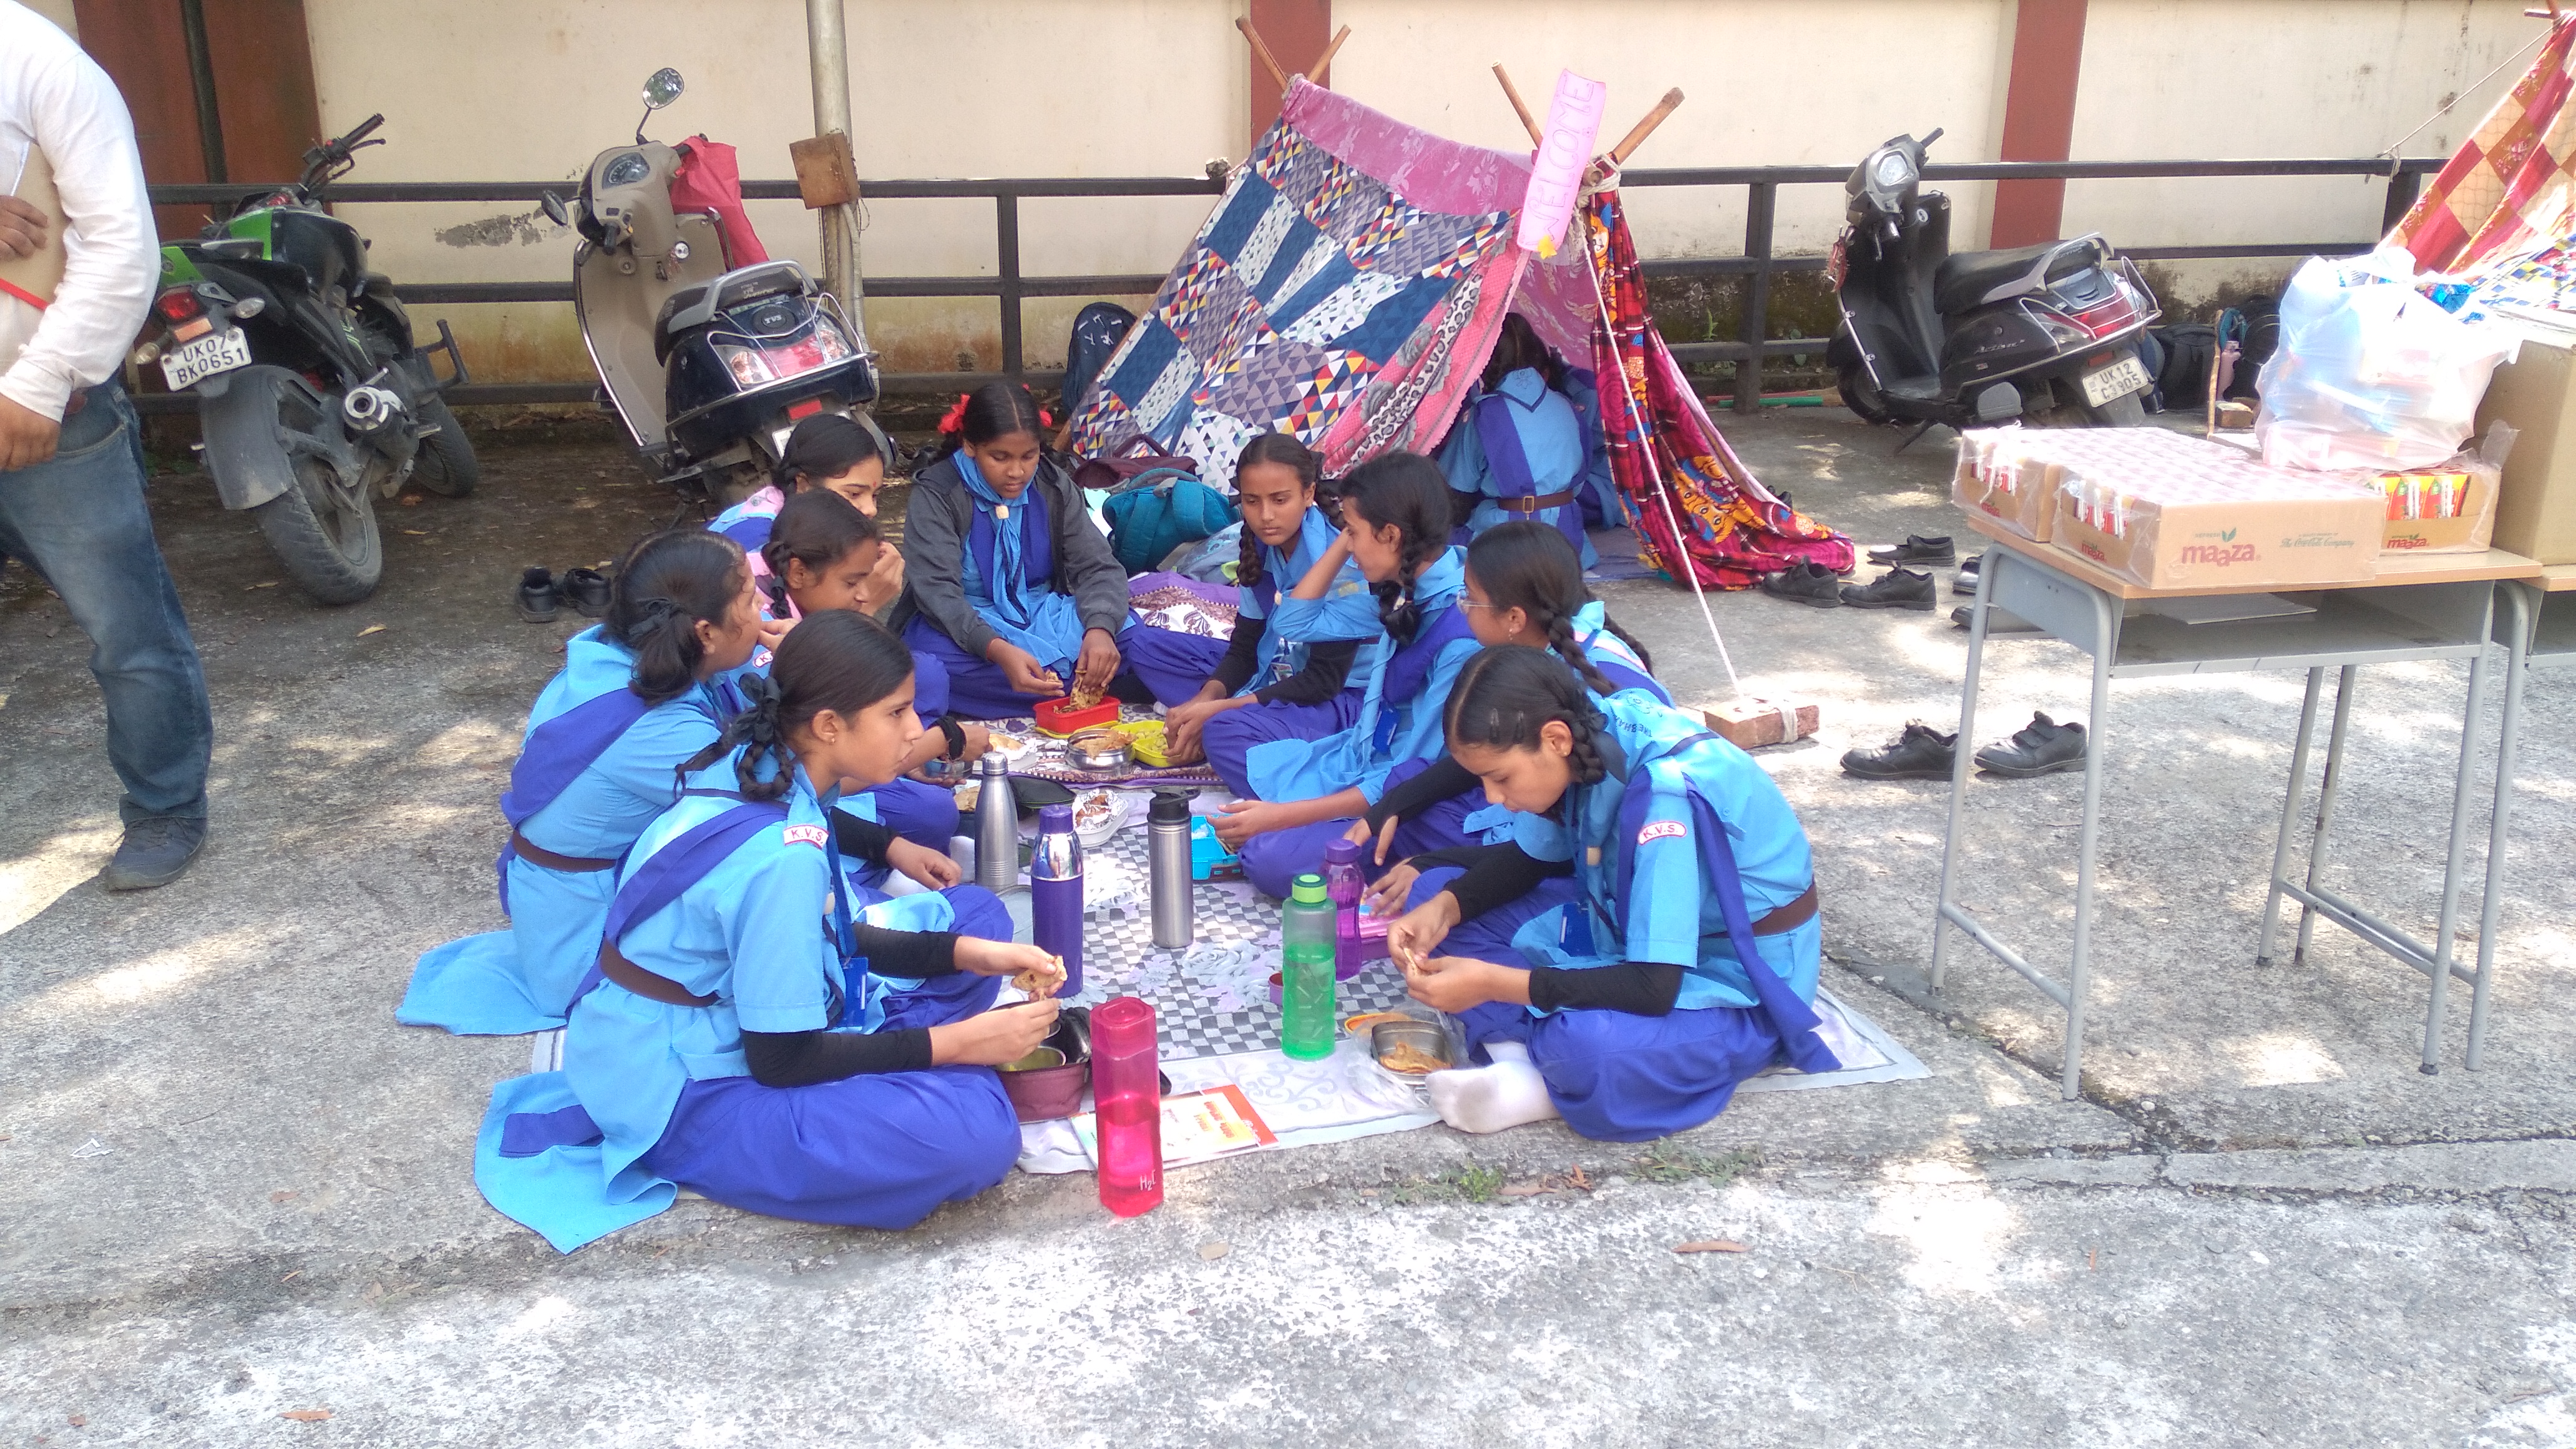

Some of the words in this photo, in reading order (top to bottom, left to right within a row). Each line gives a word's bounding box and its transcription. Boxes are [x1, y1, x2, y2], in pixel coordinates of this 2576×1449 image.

[1526, 74, 1595, 245] WELCOME
[764, 315, 782, 324] TVS
[177, 348, 245, 384] BK0651
[2099, 363, 2134, 384] UK12
[2387, 537, 2427, 549] maaza
[2182, 544, 2256, 567] maaza
